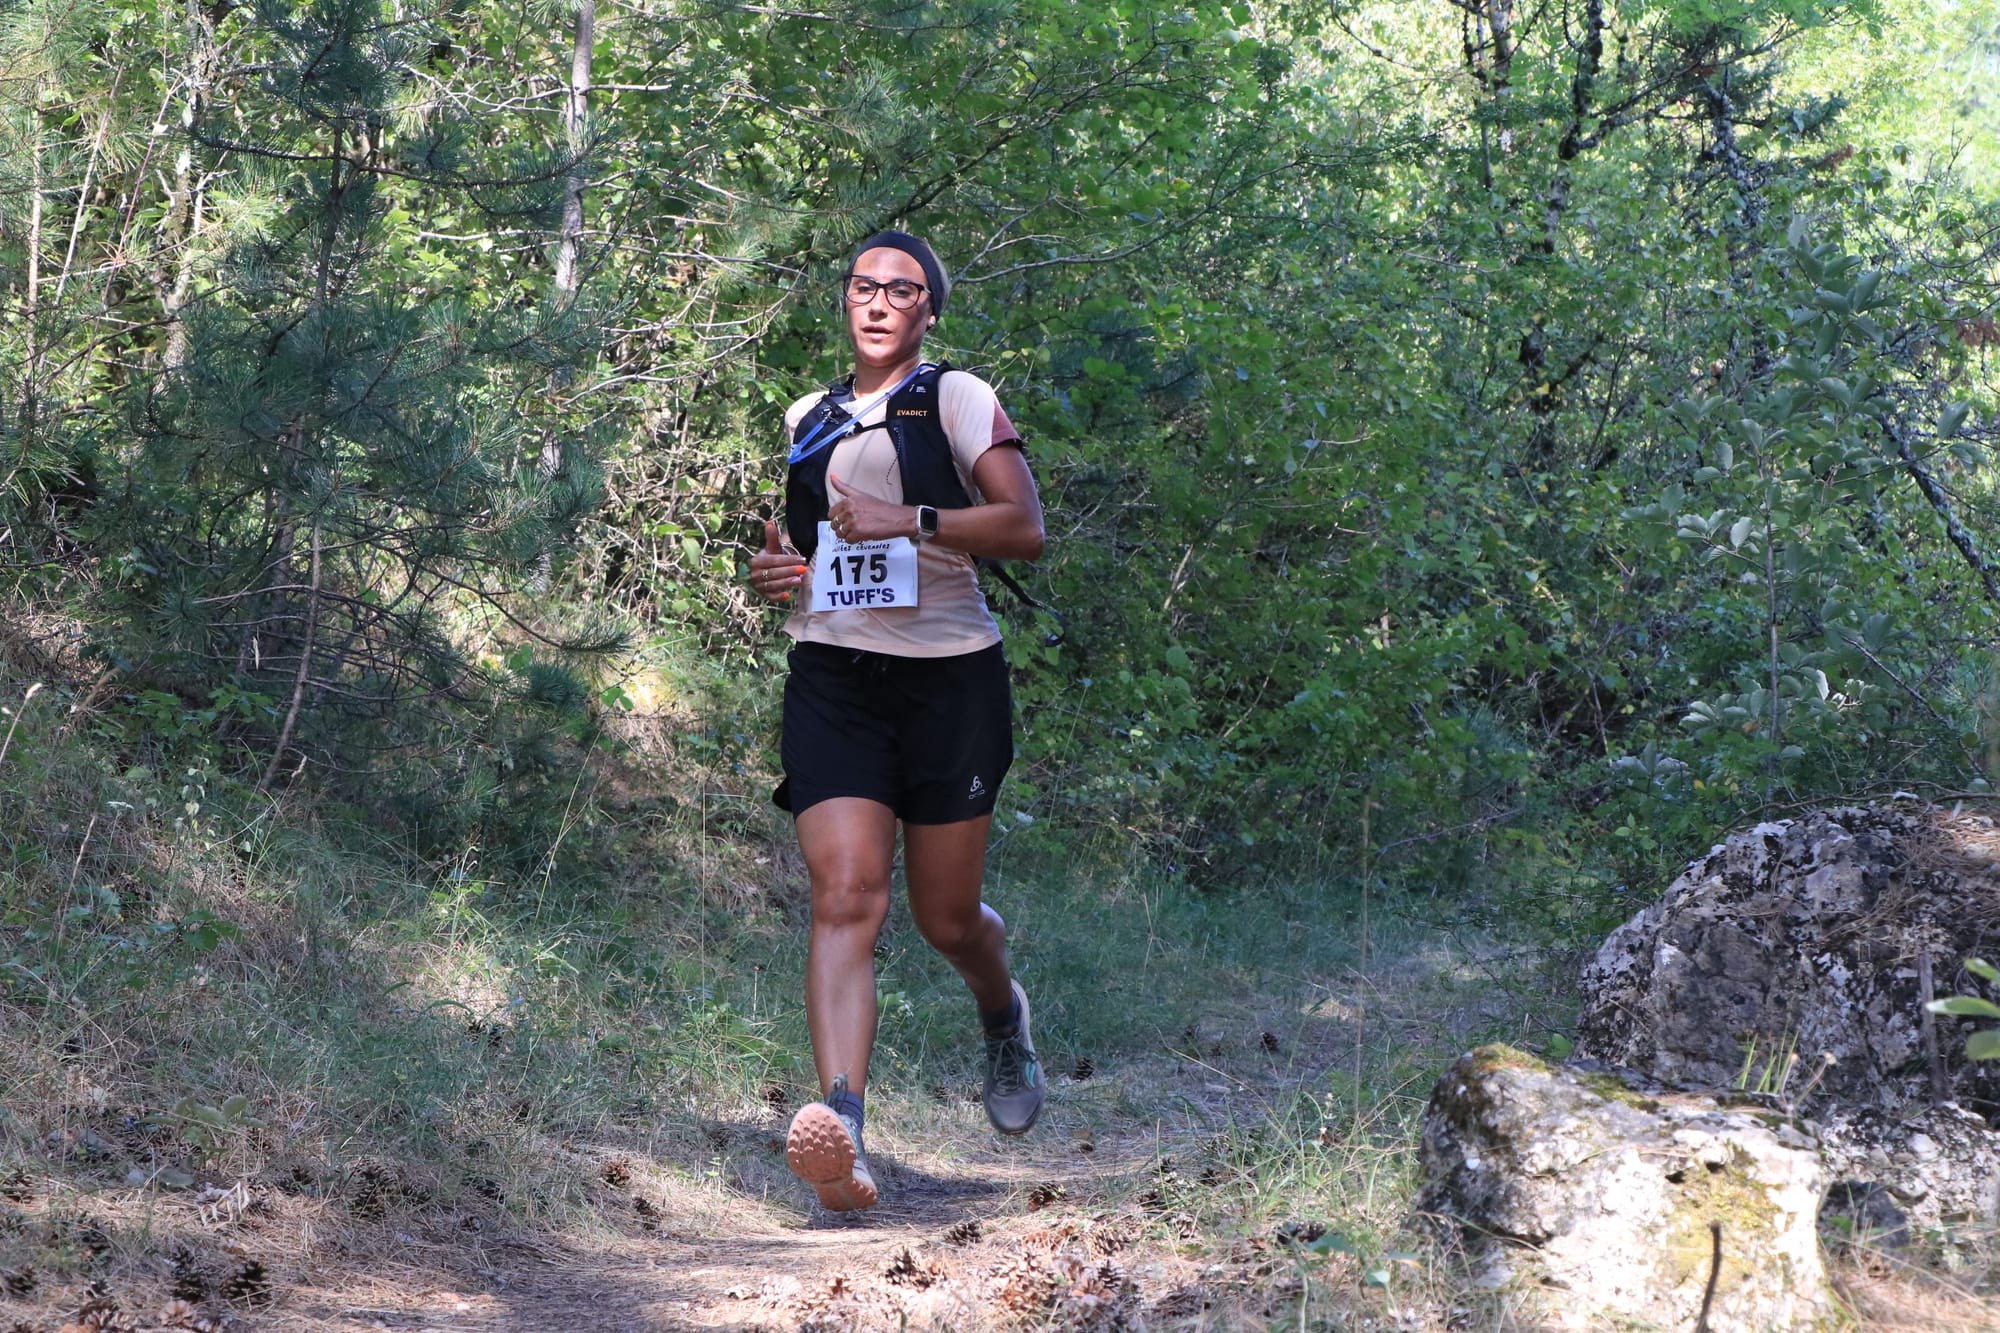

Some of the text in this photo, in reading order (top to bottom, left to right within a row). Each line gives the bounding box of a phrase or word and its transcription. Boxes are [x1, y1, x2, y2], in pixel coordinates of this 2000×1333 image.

[896, 409, 928, 417] EVADICT
[830, 553, 888, 586] 175
[827, 587, 895, 607] TUFF'S
